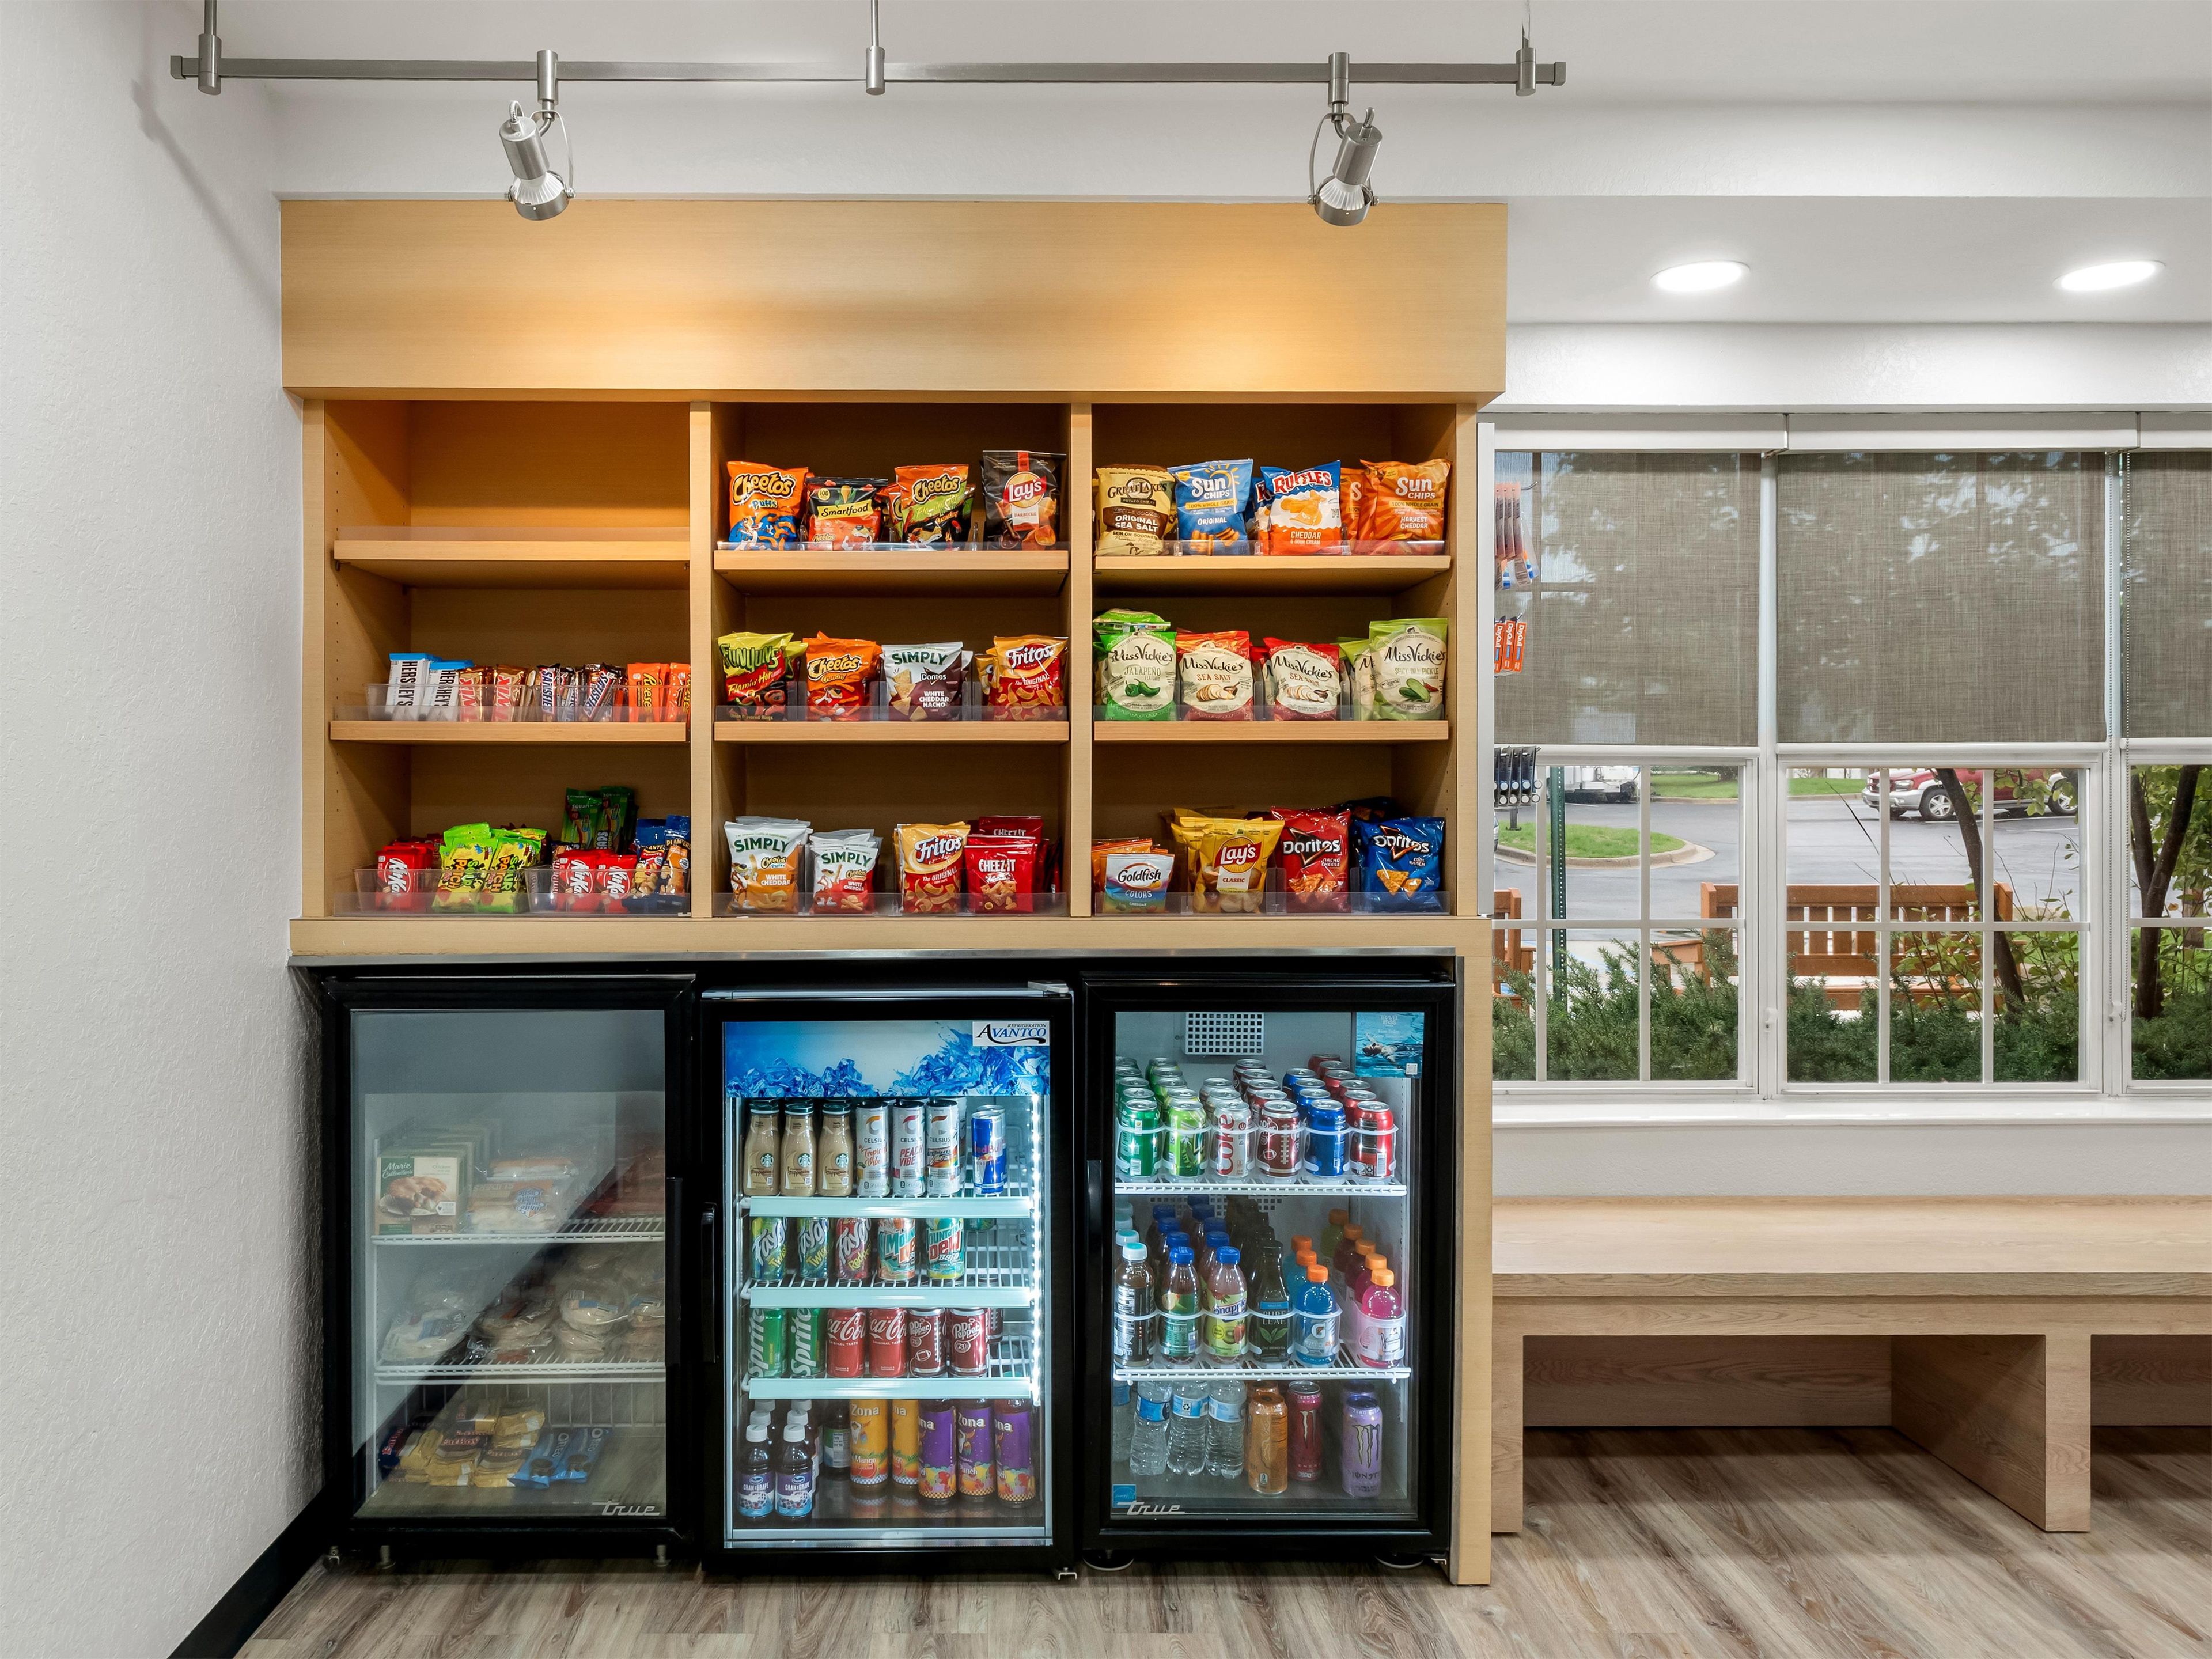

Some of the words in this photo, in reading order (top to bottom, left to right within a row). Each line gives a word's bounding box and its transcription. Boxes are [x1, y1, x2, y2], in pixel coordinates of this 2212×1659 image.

[733, 471, 795, 505] Cheetos
[913, 474, 960, 504] Cheetos
[1009, 479, 1043, 502] Lay's
[1191, 477, 1226, 497] Sun
[1272, 470, 1332, 494] RUFFLES
[1396, 476, 1433, 497] Sun
[1203, 490, 1230, 500] CHIPS
[1408, 491, 1436, 499] CHIPS
[749, 499, 777, 509] Puffs
[821, 505, 869, 517] Smartfood
[1115, 514, 1158, 526] ORIGINAL
[1136, 522, 1158, 532] SALT
[1198, 517, 1227, 525] ORIGINAL
[812, 533, 835, 545] Cheetos
[1290, 531, 1321, 540] CHEDDAR
[1517, 625, 1525, 646] DayQuil
[720, 643, 779, 672] FUNYUNS
[892, 651, 948, 665] SIMPLY
[1005, 646, 1052, 669] Fritos
[1112, 649, 1139, 662] Miss
[1134, 643, 1173, 666] Vickie's
[1384, 646, 1411, 662] Miss
[808, 654, 861, 680] Cheetos
[1182, 658, 1209, 673] Miss
[1205, 657, 1244, 674] Vickie's
[1274, 656, 1299, 672] Miss
[1295, 659, 1334, 681] Vickie's
[396, 661, 418, 706] HERSHEY'S
[728, 679, 757, 696] Flamin'
[758, 671, 773, 684] Hot
[821, 673, 846, 684] Crunchy
[1023, 673, 1050, 685] ORIGINAL
[1289, 672, 1303, 680] SEA
[734, 837, 790, 853] SIMPLY
[915, 836, 963, 863] Fritos
[1283, 839, 1341, 854] Doritos
[1373, 834, 1430, 853] Doritos
[761, 855, 787, 868] Cheetos
[821, 852, 872, 867] SIMPLY
[1220, 844, 1256, 865] Lay's
[448, 859, 468, 888] PATCH
[461, 861, 479, 886] SOUR
[491, 856, 510, 892] PATCH
[501, 856, 518, 891] SOUR
[846, 869, 867, 878] Cheetos
[931, 867, 957, 881] ORIGINAL
[1118, 868, 1161, 883] Goldfish
[1125, 889, 1153, 899] COLORS
[975, 1024, 1046, 1041] AVANTCO
[384, 1162, 412, 1172] Marie
[900, 1156, 916, 1166] VIBE
[1214, 1298, 1246, 1315] Snappe
[953, 1324, 980, 1340] Pepper
[748, 1308, 768, 1378] Sprite
[791, 1308, 816, 1377] Sprite
